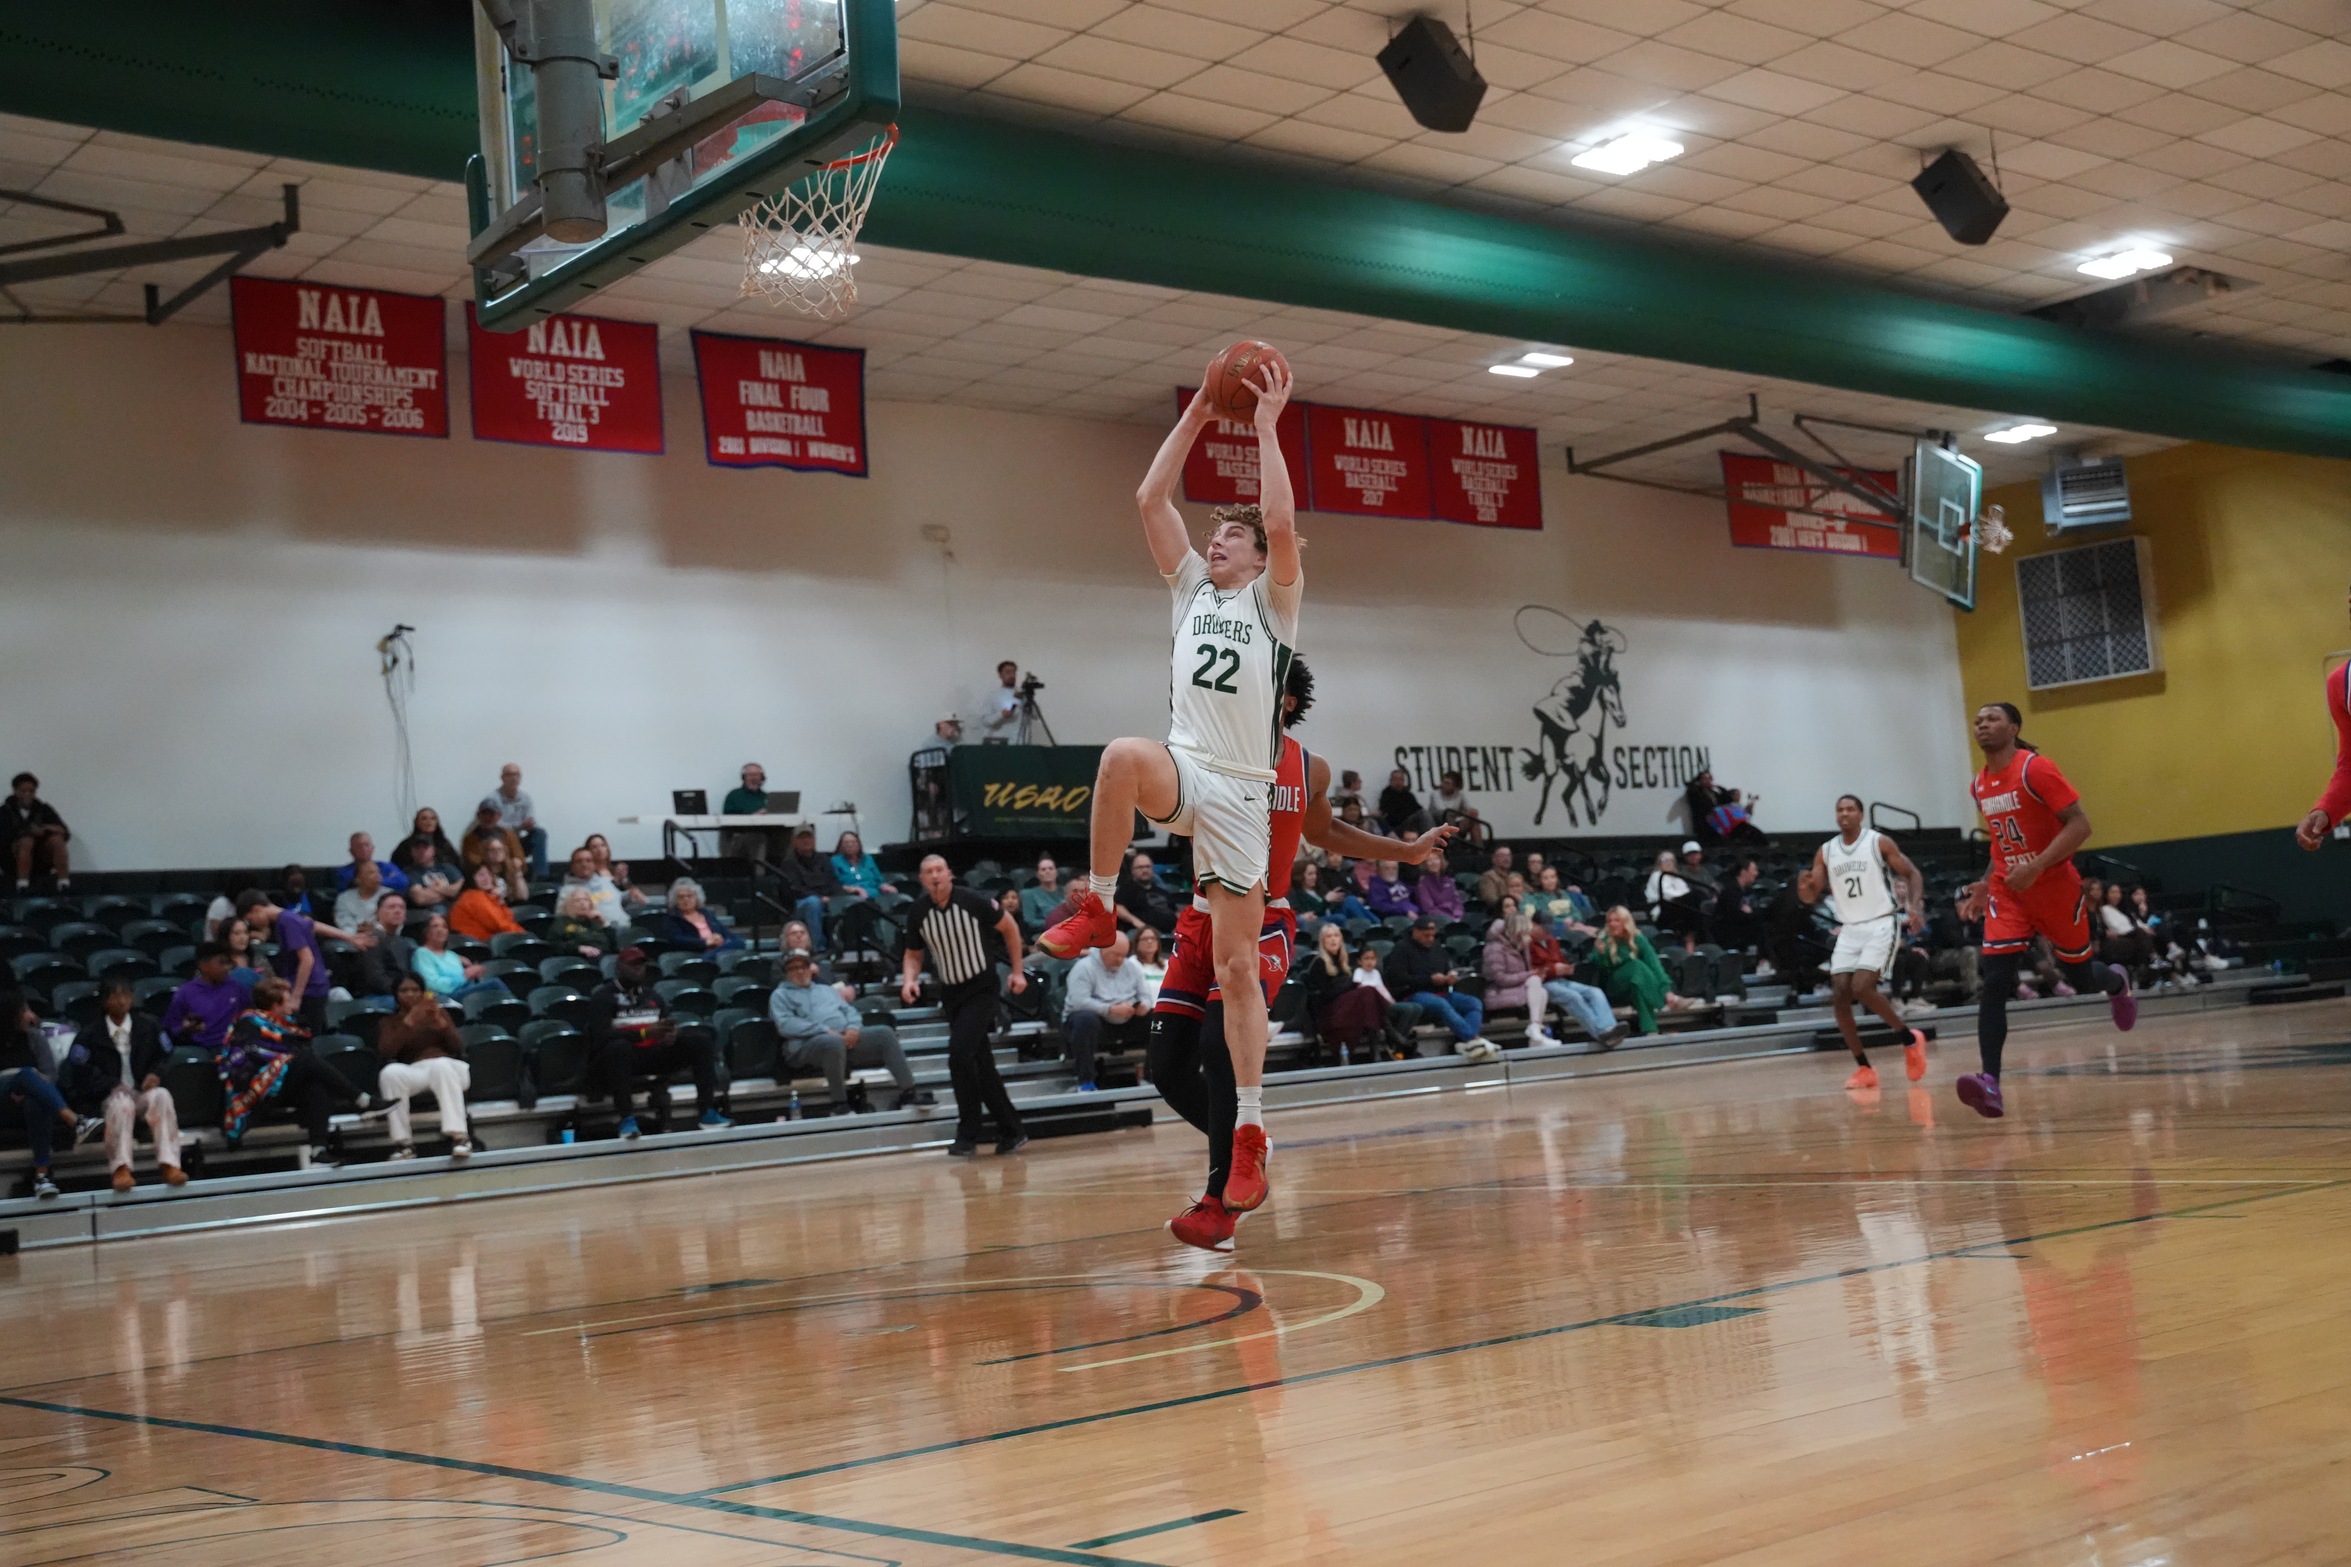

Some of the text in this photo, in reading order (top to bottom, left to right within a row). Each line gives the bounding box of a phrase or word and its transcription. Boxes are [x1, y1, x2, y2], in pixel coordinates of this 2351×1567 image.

[298, 289, 385, 337] NAIA
[296, 337, 388, 365] SOFTBALL
[527, 319, 606, 361] NAIA
[245, 352, 438, 390] NATIONAL TOURNAMENT
[509, 357, 625, 388] WORLD SERIES
[758, 349, 807, 383] NAIA
[273, 377, 414, 408] CHAMPIONSHIPS
[525, 380, 610, 407] SOFTBALL
[738, 380, 830, 413] FINAL FOUR
[265, 396, 308, 421] 2004
[324, 401, 368, 426] 2005
[382, 407, 425, 429] 2006
[537, 401, 600, 425] FINAL 3
[745, 409, 827, 437] BASKETBALL
[1343, 417, 1395, 451] NAIA
[1460, 425, 1507, 459] NAIA
[1334, 454, 1407, 477] WORLD SERIES
[1345, 472, 1398, 492] BASEBALL
[1192, 643, 1240, 694] 22
[1394, 745, 1711, 792] STUDENT SECTION
[983, 782, 1092, 812] USAO
[1990, 815, 2028, 852] 24
[1845, 876, 1863, 899] 21
